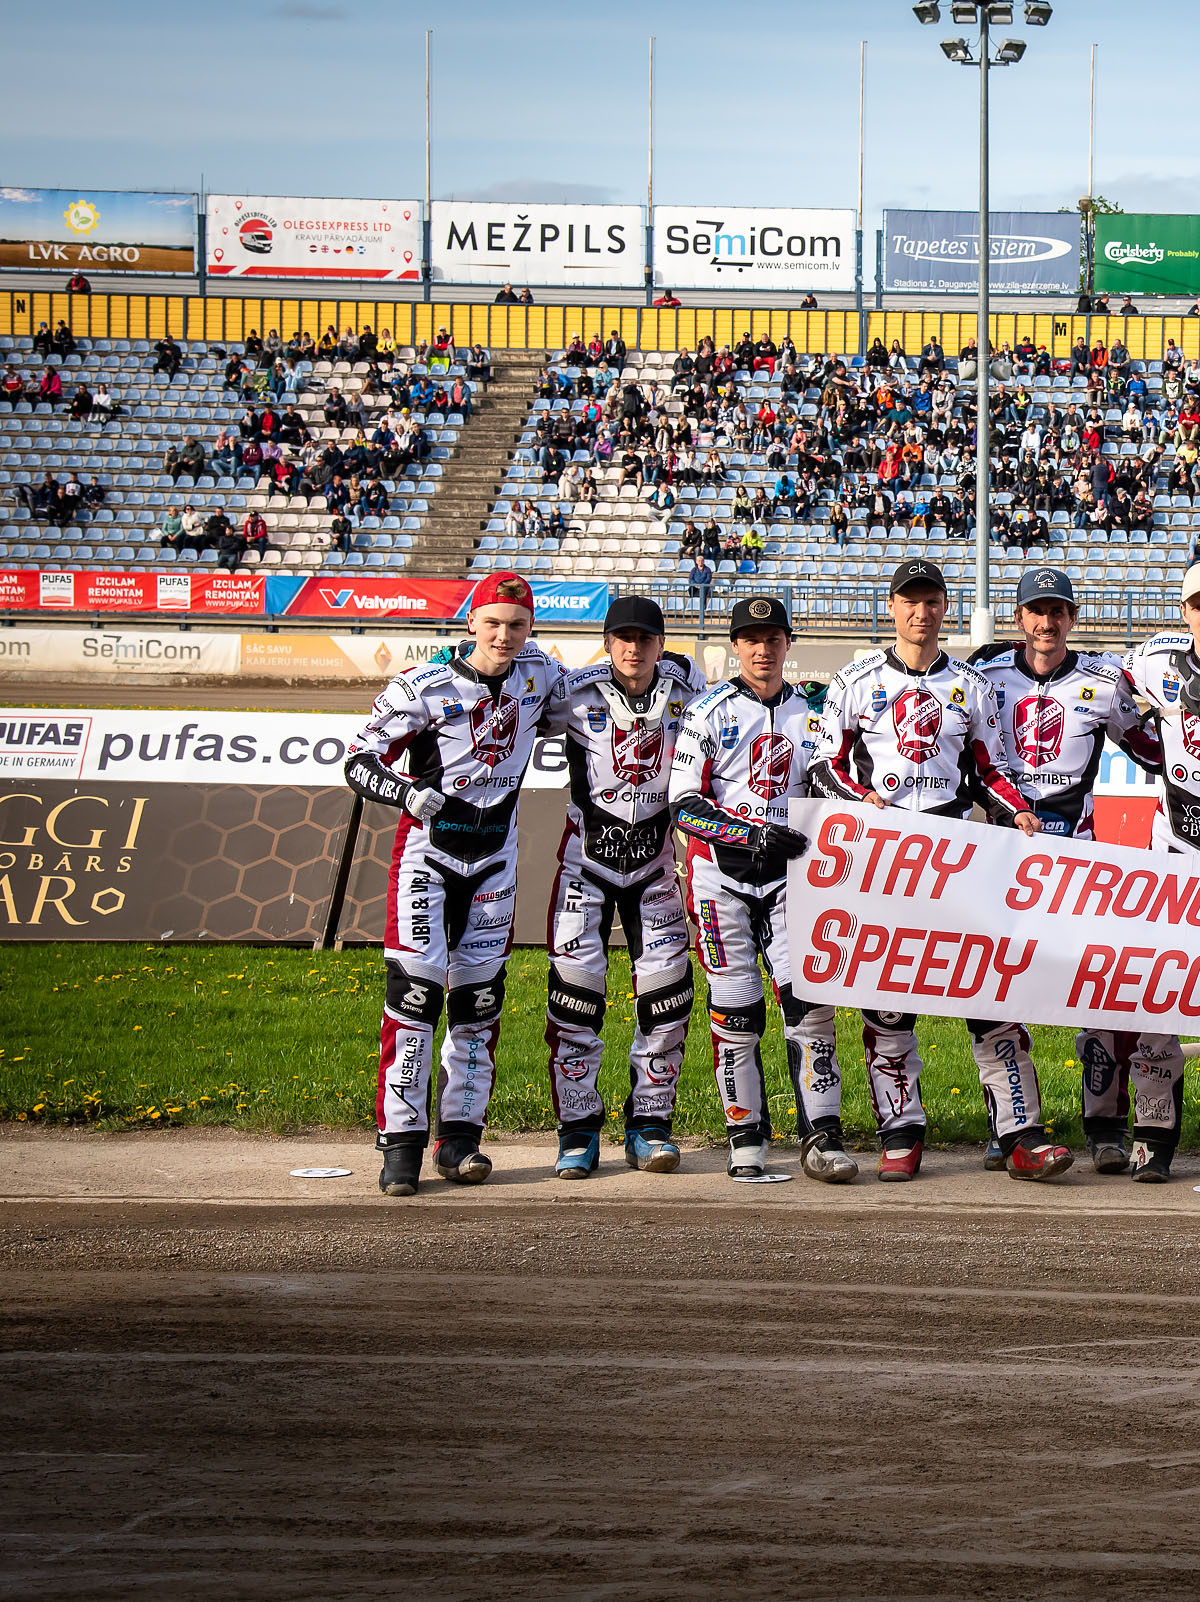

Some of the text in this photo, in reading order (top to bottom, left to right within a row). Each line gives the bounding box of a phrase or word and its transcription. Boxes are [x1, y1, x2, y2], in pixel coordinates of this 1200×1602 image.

[283, 219, 392, 232] OLEGSEXPRESS LTD
[295, 233, 322, 242] KRAVU
[447, 214, 626, 255] MEŽPILS
[666, 224, 841, 257] SemiCom
[28, 244, 140, 263] LVK AGRO
[892, 235, 1037, 260] Tapetes vsiem
[1104, 241, 1164, 264] Carlsberg
[1167, 250, 1199, 259] Probably
[756, 260, 841, 271] www.semicom.lv
[893, 279, 928, 288] Stadiona
[929, 280, 937, 289] 2,
[16, 299, 26, 313] N
[1055, 322, 1067, 336] M
[42, 574, 72, 584] PUFAS
[96, 577, 136, 587] IZCILAM
[159, 577, 189, 586] PUFAS
[212, 580, 252, 589] IZCILAM
[88, 587, 143, 598] REMONTAM
[205, 590, 260, 600] REMONTAM
[205, 600, 259, 608] WWW.PUFAS.LV
[353, 593, 429, 610] Valvoline
[533, 595, 590, 609] TOKKER
[83, 637, 201, 660] SemiCom
[1149, 637, 1190, 647] TRODO
[267, 645, 292, 655] SAVU
[411, 667, 448, 686] TRODO
[569, 668, 609, 686] TRODO
[800, 671, 830, 680] prakse
[696, 683, 730, 711] TRODO
[899, 699, 936, 734] LOKOMOTIV
[1017, 705, 1058, 737] LOKOMOTIV
[12, 756, 76, 768] IN GERMANY
[753, 741, 789, 772] LOKOMOTIV
[370, 774, 379, 793] &
[904, 775, 951, 790] OPTIBET
[1022, 773, 1073, 785] OPTIBET
[681, 814, 728, 837] CARPETS 4
[806, 812, 978, 900] STAY
[411, 897, 430, 910] &
[468, 911, 513, 927] Interio
[411, 914, 431, 945] JBM
[461, 937, 506, 950] TRODO
[802, 908, 1039, 1002] SPEEDY
[400, 1001, 423, 1014] Systems
[550, 990, 597, 1016] ALPROMO
[652, 987, 694, 1015] ALPROMO
[563, 1087, 598, 1100] YOGGI
[1004, 1058, 1027, 1126] STOKKER
[566, 1099, 593, 1111] BEAR
